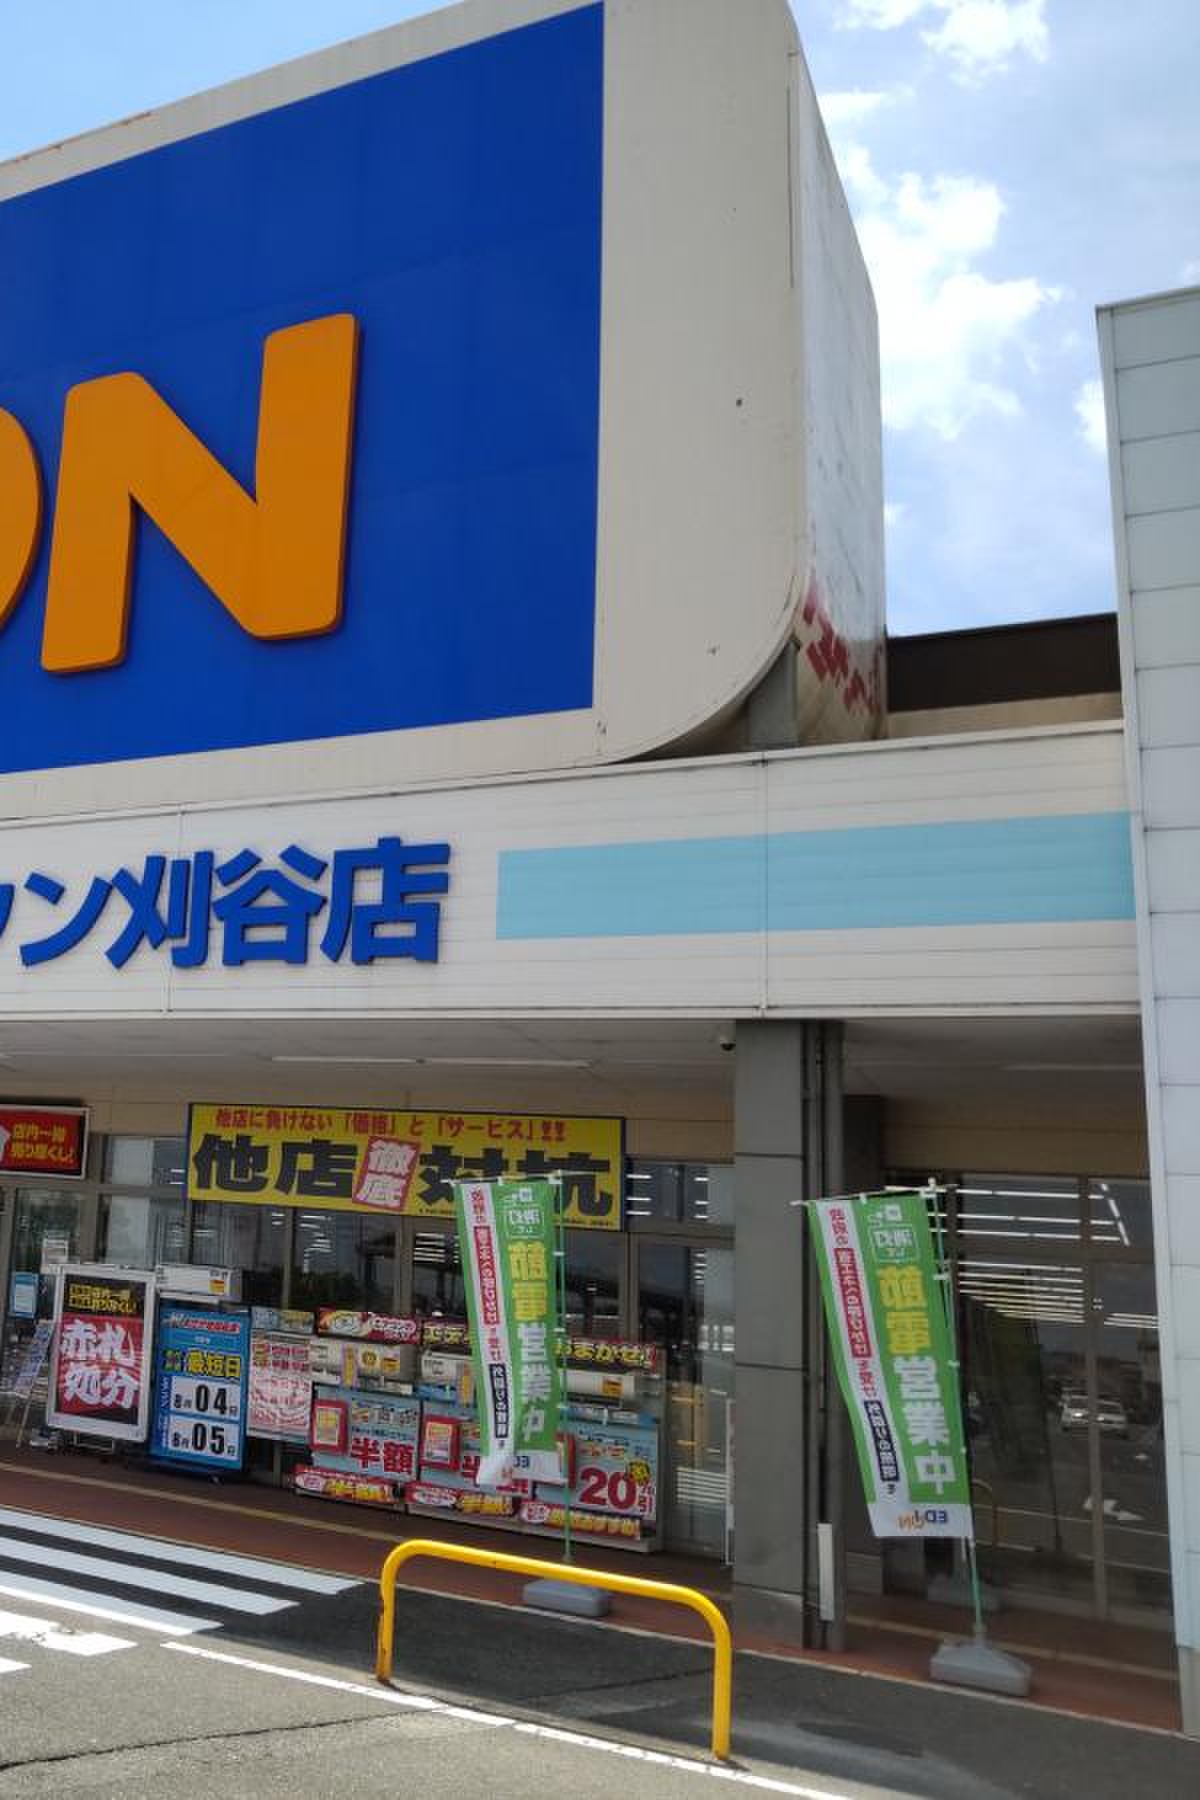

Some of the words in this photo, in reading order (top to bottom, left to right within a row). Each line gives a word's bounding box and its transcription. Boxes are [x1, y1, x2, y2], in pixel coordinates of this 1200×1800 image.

[193, 1133, 359, 1198] 他店
[61, 1320, 134, 1367] 赤札
[64, 1368, 140, 1409] 処分
[350, 1436, 414, 1475] 半額
